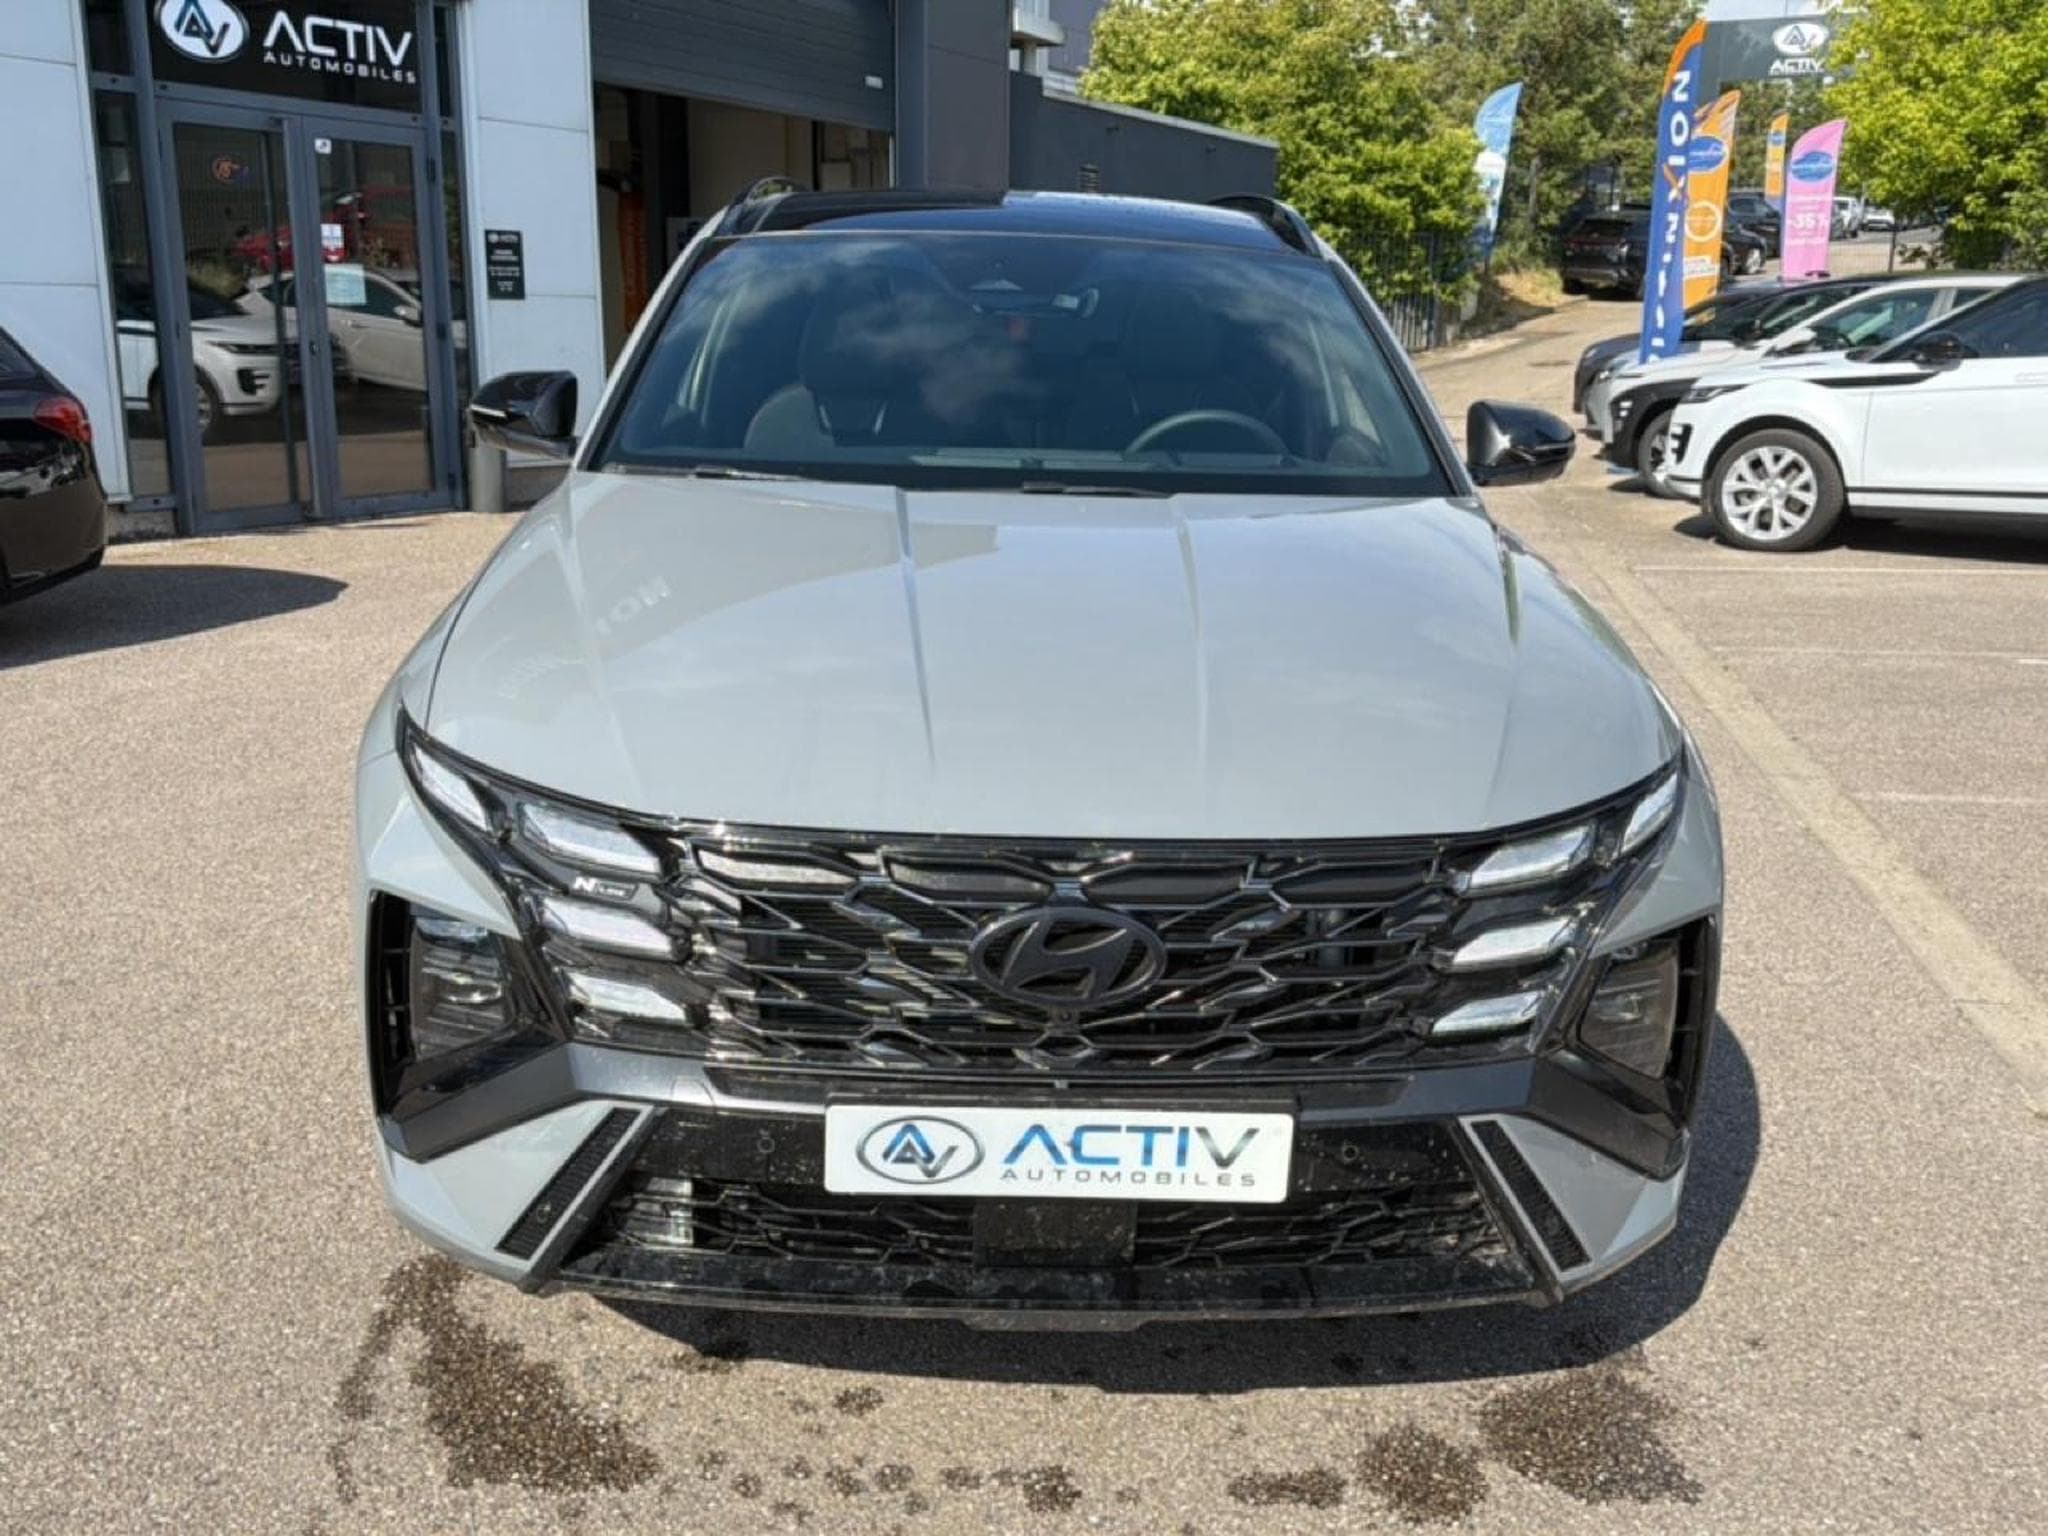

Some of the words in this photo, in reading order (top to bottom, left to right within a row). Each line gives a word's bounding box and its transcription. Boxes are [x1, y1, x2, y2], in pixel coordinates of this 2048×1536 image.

[263, 10, 412, 66] ACTIV
[263, 50, 417, 84] AUTOMOBILES
[1002, 1122, 1261, 1170] ACTIV
[1000, 1168, 1256, 1187] AUTOMOBILES
